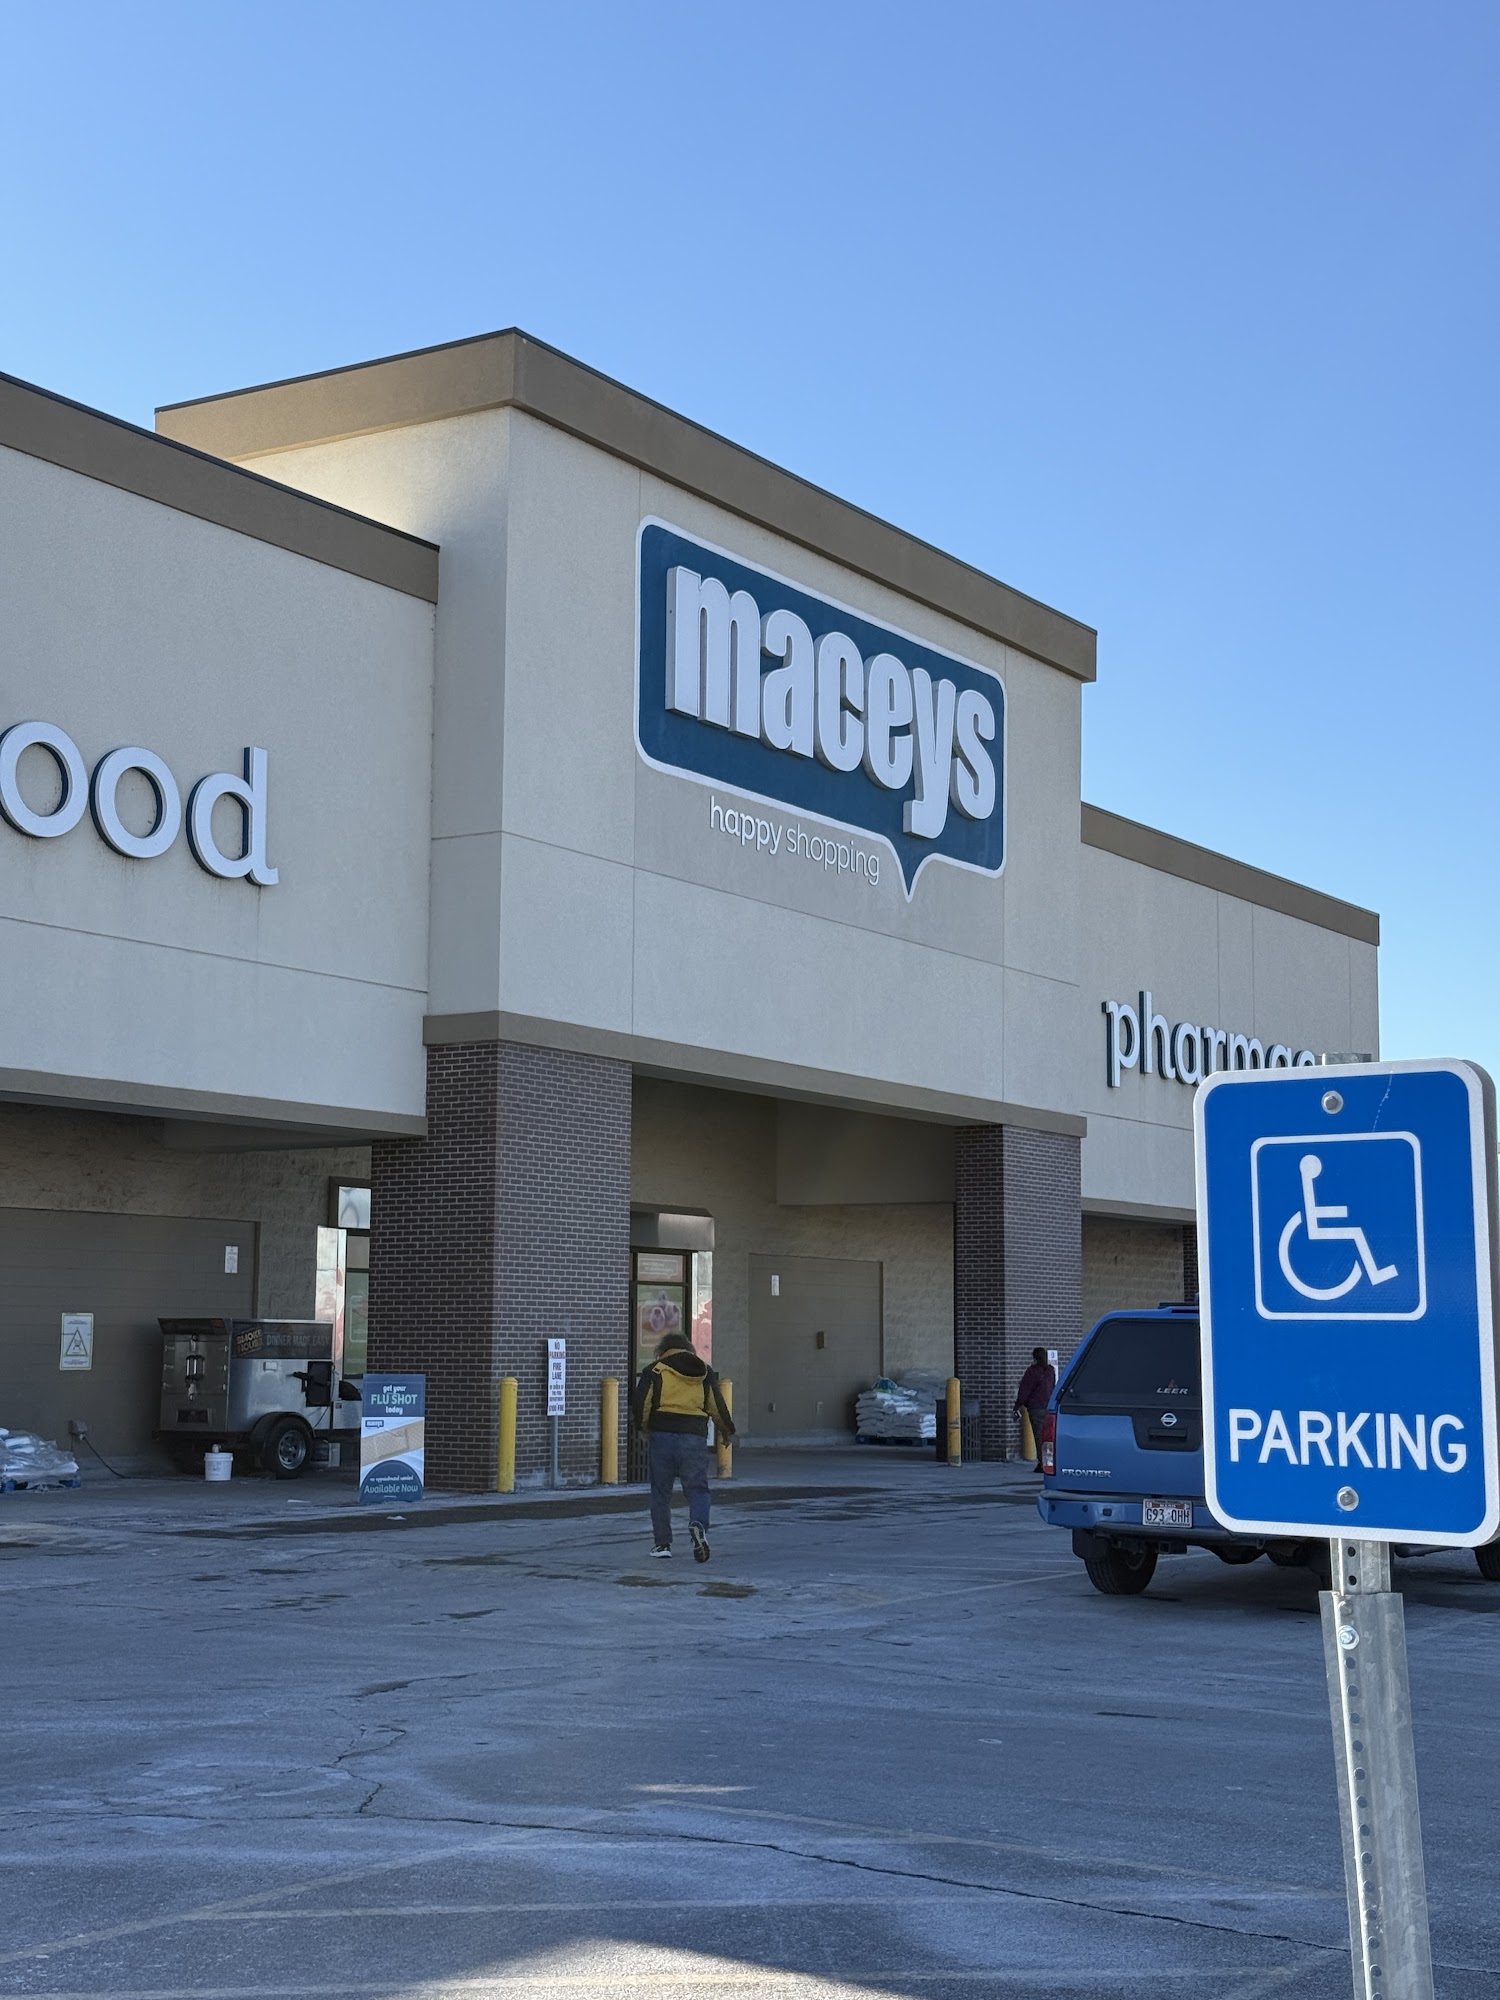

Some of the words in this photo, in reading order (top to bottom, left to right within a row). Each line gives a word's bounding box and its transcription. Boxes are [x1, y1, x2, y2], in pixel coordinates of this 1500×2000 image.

[665, 565, 996, 839] maceys
[710, 796, 782, 855] happy
[786, 823, 880, 886] shopping
[1101, 990, 1316, 1088] pharm
[552, 1371, 563, 1380] LANE
[382, 1384, 392, 1394] get
[393, 1384, 406, 1394] your
[1156, 1387, 1189, 1395] LEER
[370, 1393, 390, 1405] FLU
[391, 1393, 418, 1405] SHOT
[385, 1405, 404, 1416] today
[1228, 1408, 1467, 1474] PARKING
[1061, 1468, 1112, 1478] FRONTIER
[364, 1483, 400, 1494] Available
[401, 1483, 419, 1493] Now
[1146, 1508, 1165, 1522] G93
